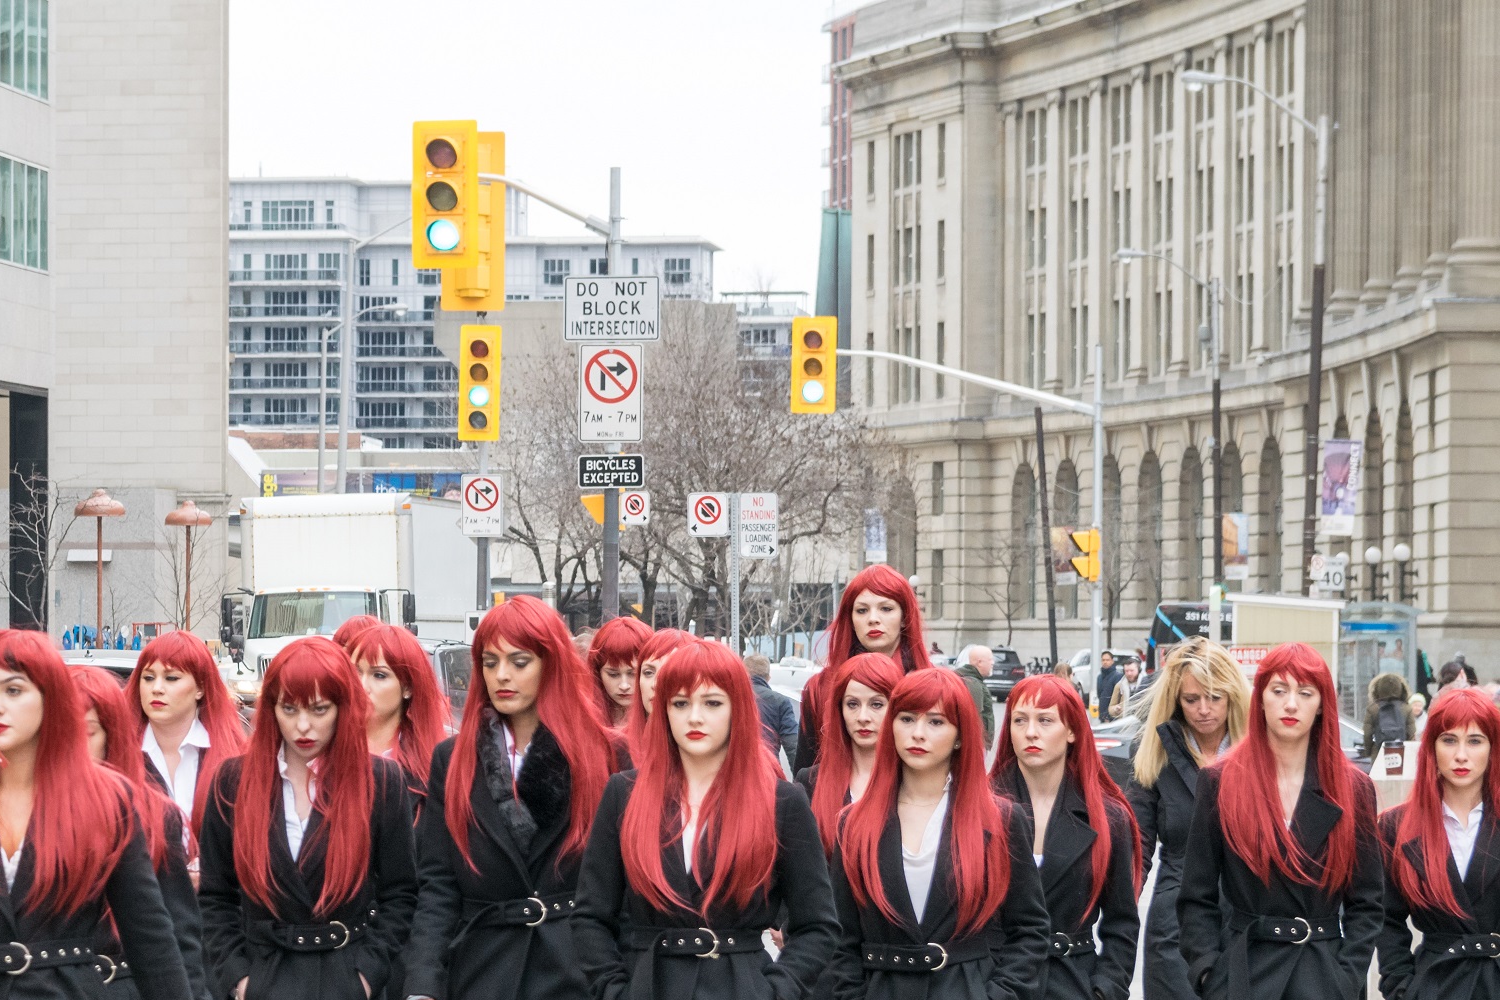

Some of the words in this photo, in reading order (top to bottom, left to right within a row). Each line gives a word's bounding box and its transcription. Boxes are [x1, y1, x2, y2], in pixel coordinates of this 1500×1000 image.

[576, 282, 599, 296] DO
[615, 281, 647, 296] NOT
[582, 300, 641, 316] BLOCK
[571, 320, 655, 336] INTERSECTION
[586, 459, 636, 471] BICYCLES
[1346, 443, 1361, 491] CONNECT
[583, 472, 639, 484] EXCEPTED
[752, 497, 764, 507] NO
[741, 510, 775, 520] STANDING
[741, 523, 776, 532] PASSENGER
[745, 534, 773, 543] LOADING
[750, 545, 767, 554] ZONE
[1322, 571, 1343, 586] 40
[1185, 611, 1200, 621] 351
[1231, 649, 1268, 660] DANGER
